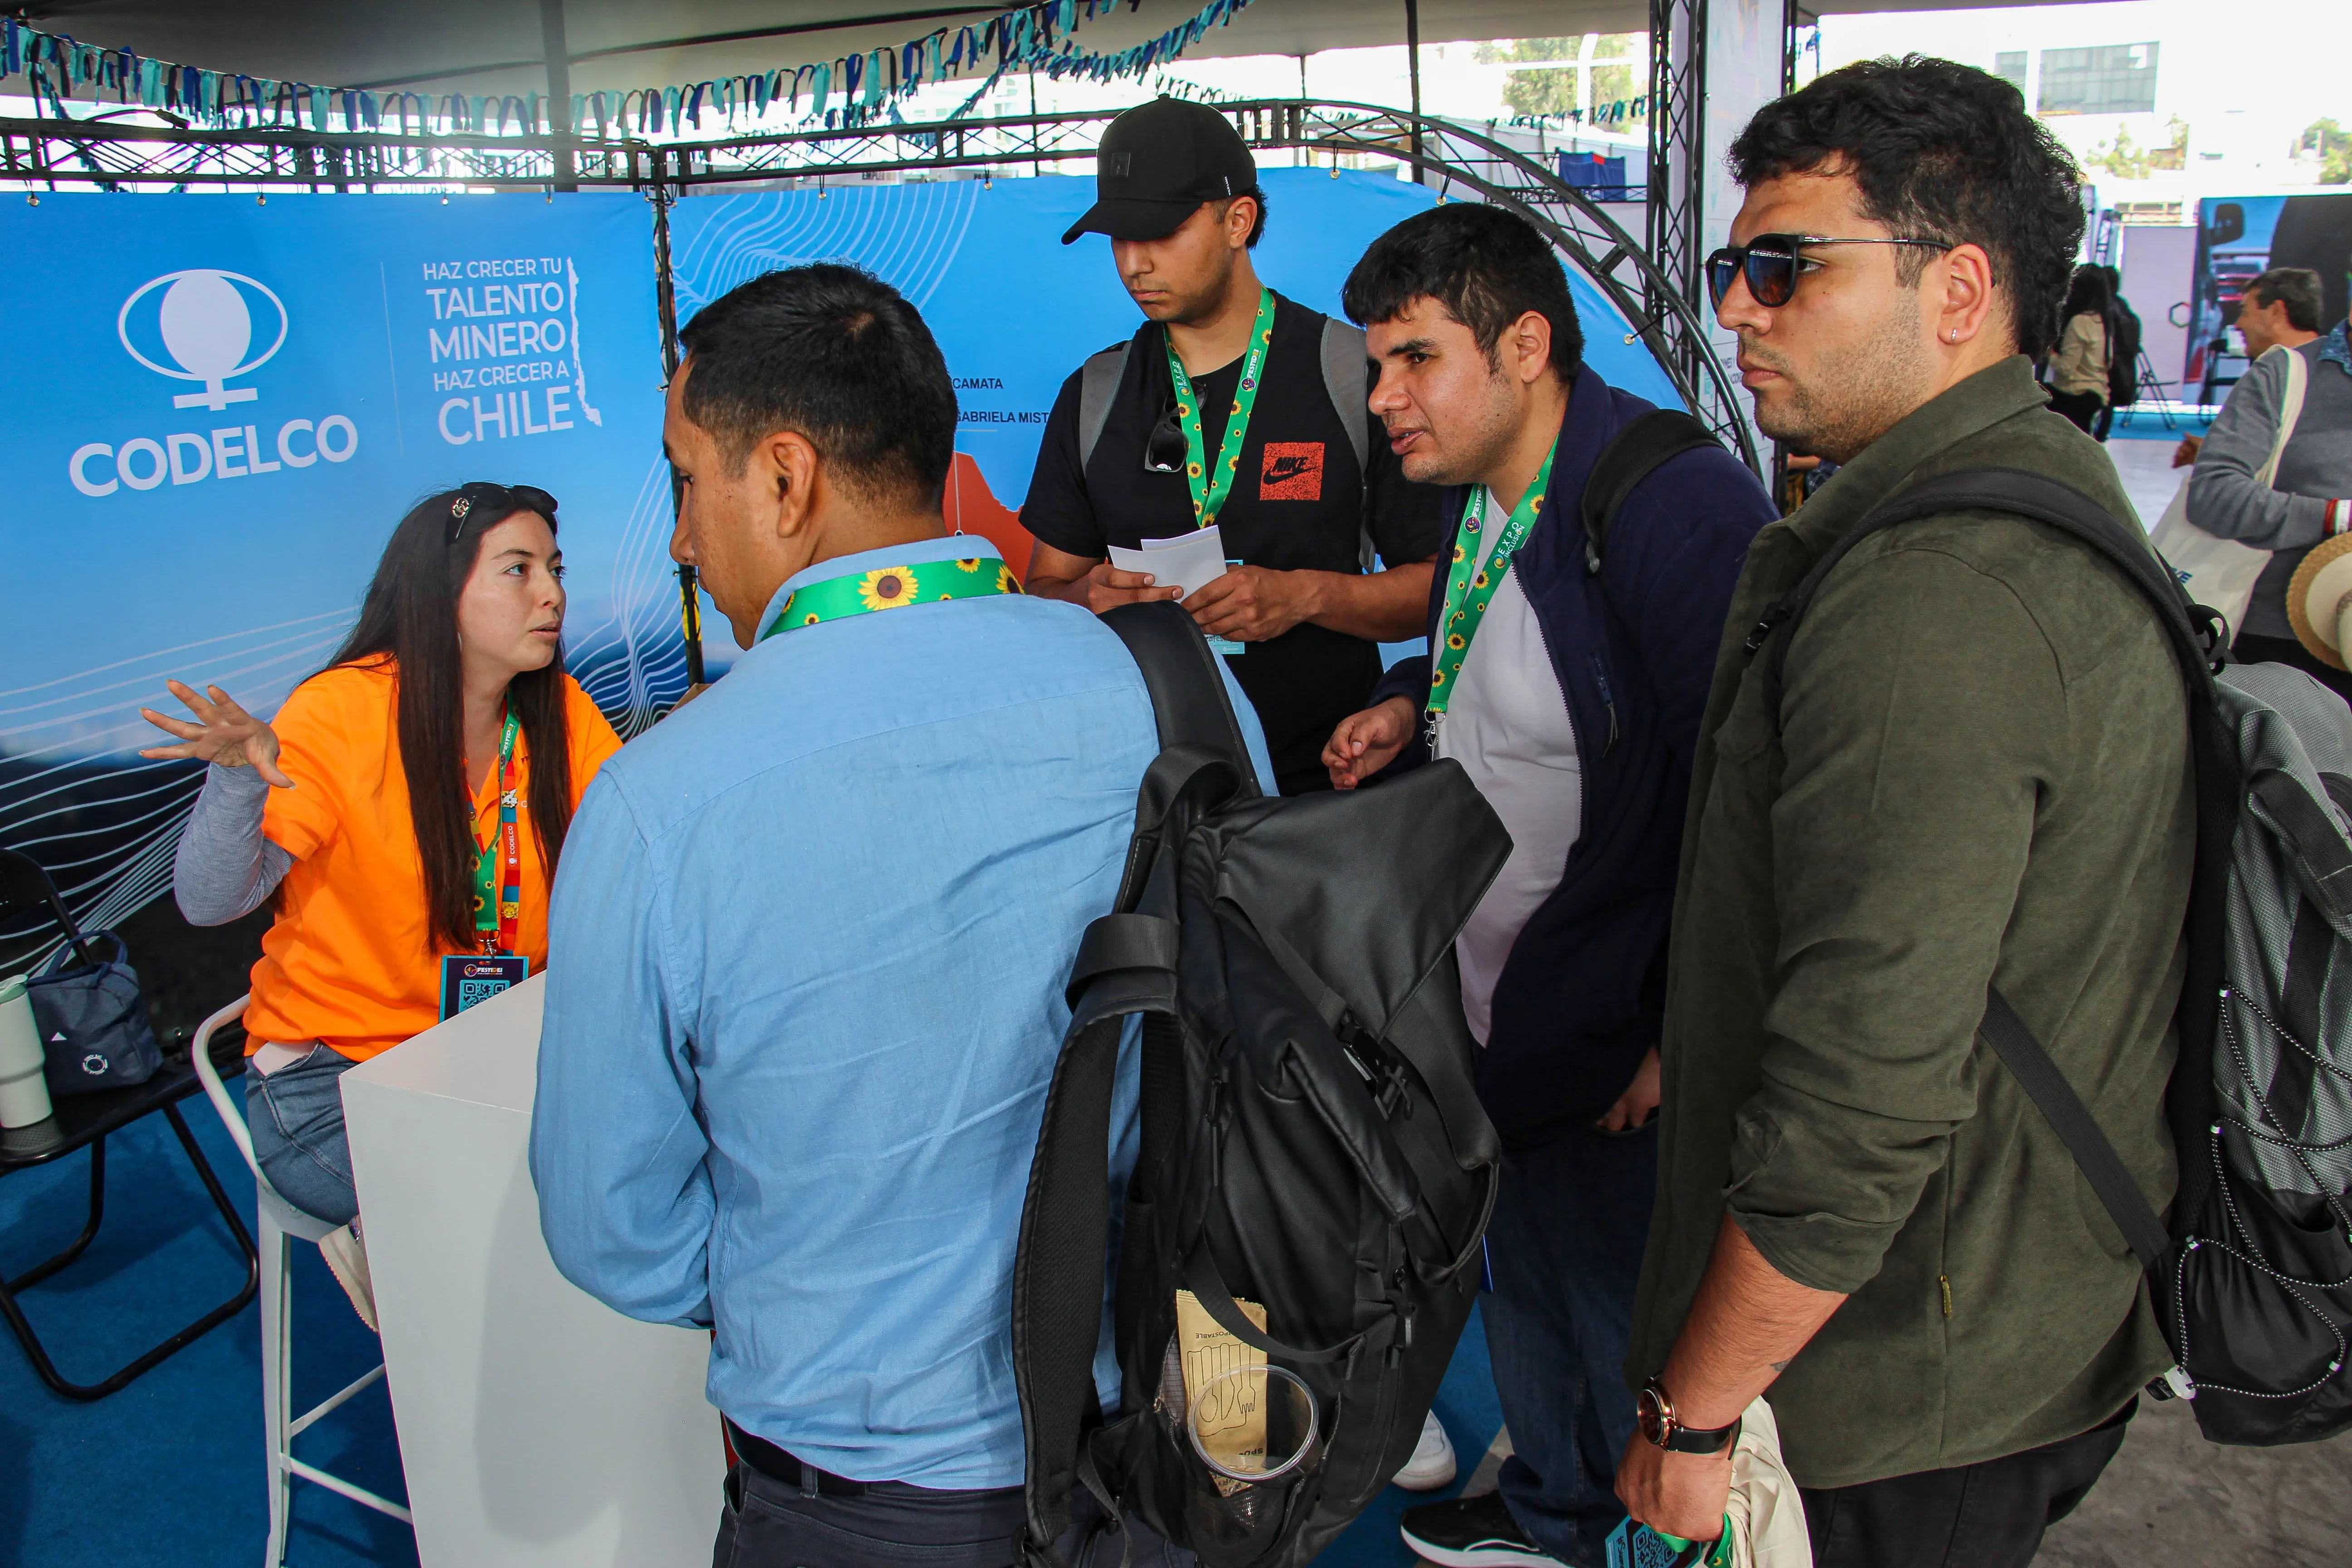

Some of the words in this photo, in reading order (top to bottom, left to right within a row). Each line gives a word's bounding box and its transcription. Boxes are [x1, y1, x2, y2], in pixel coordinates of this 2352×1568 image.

[423, 262, 463, 280] HAZ
[466, 258, 537, 279] CRECER
[540, 257, 562, 274] TU
[426, 281, 564, 320] TALENTO
[429, 318, 566, 363] MINERO
[433, 369, 475, 392] HAZ
[478, 361, 554, 387] CRECER
[556, 360, 570, 378] A
[1172, 361, 1183, 386] EXPO
[438, 385, 574, 445] CHILE
[69, 414, 358, 497] CODELCO
[1271, 456, 1309, 472] NIKE
[1498, 522, 1519, 554] EXPO
